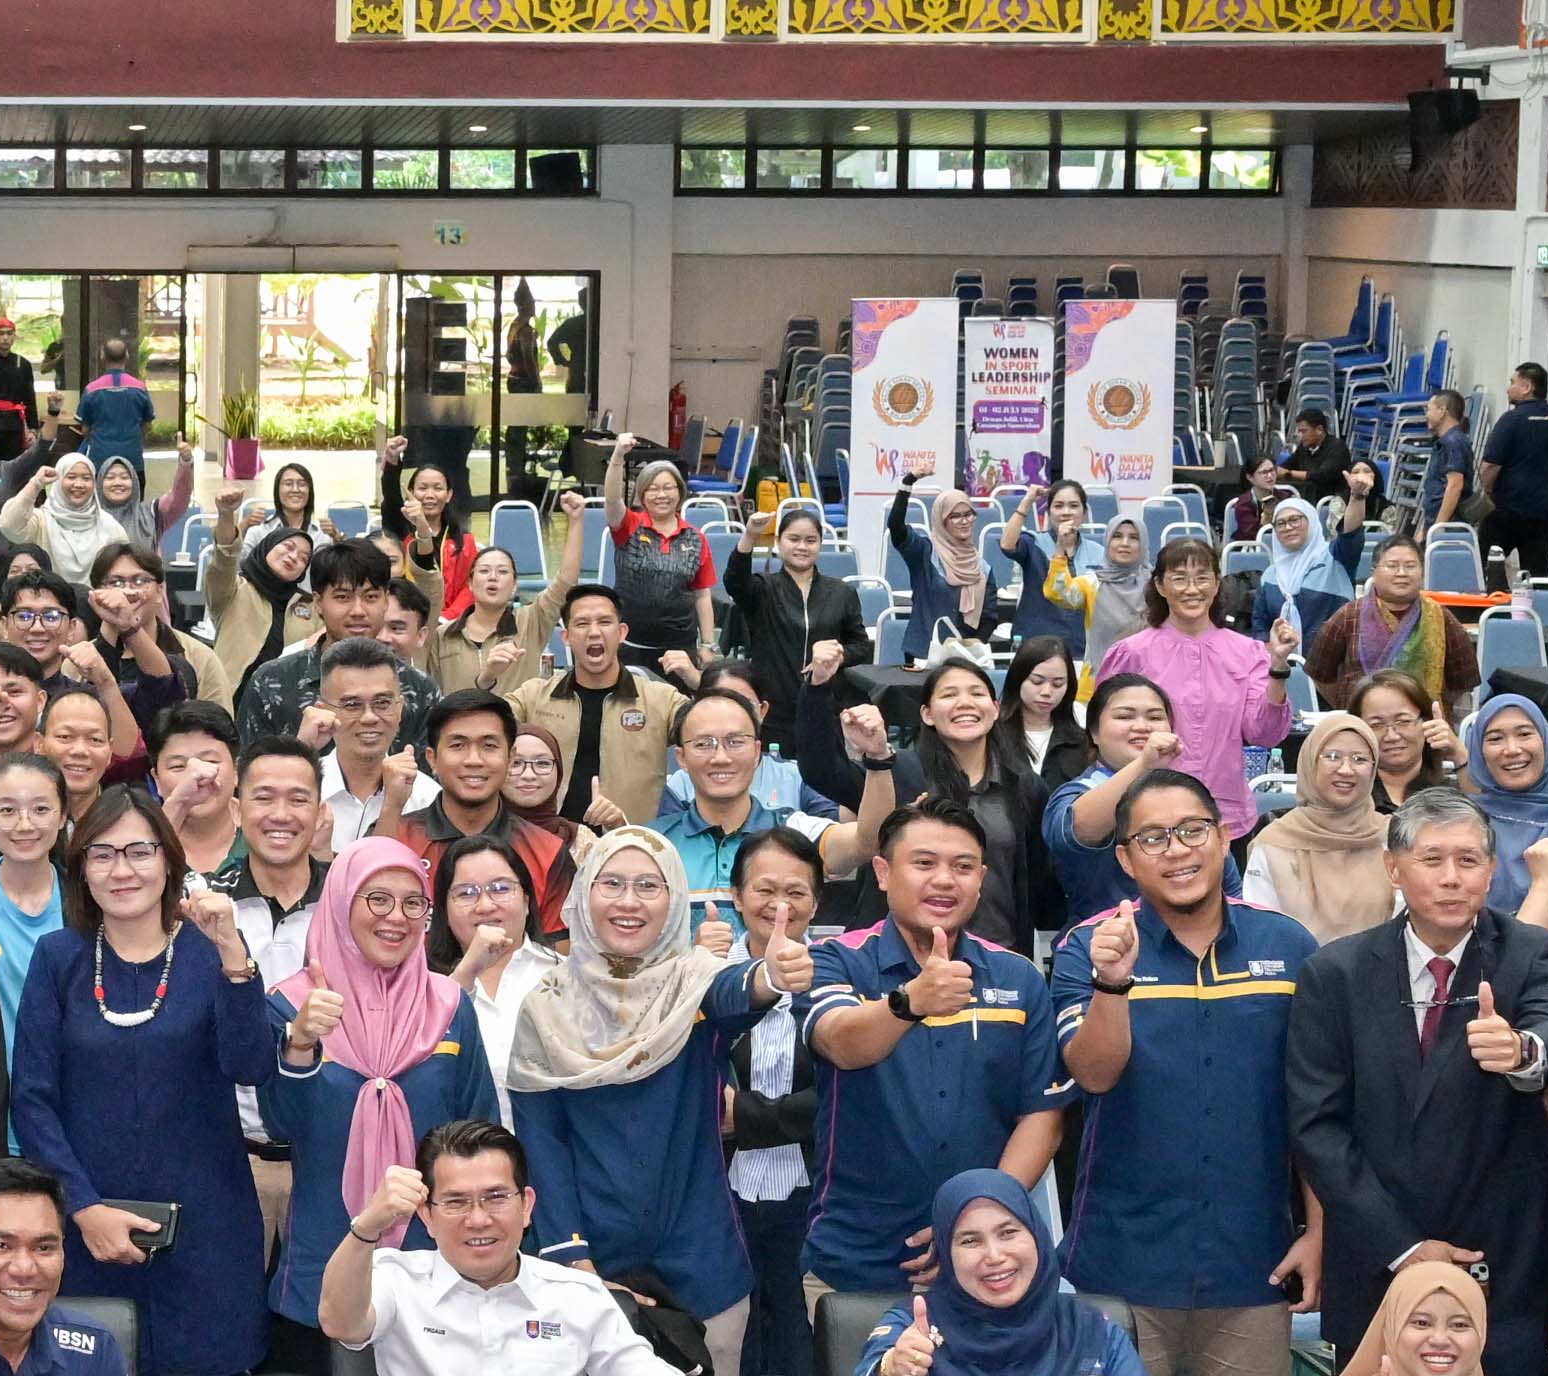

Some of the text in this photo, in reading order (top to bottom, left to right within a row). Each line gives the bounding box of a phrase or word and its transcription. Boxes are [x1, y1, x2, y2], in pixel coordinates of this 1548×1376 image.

[984, 348, 1039, 359] WOMEN
[985, 362, 1038, 370] IN SPORT
[972, 372, 1051, 383] LEADERSHIP
[985, 386, 1036, 394] SEMINAR
[1119, 455, 1153, 463] WANITA
[1118, 464, 1153, 472] DALAM
[1116, 472, 1151, 480] SUKAN
[59, 1329, 95, 1351] BSN
